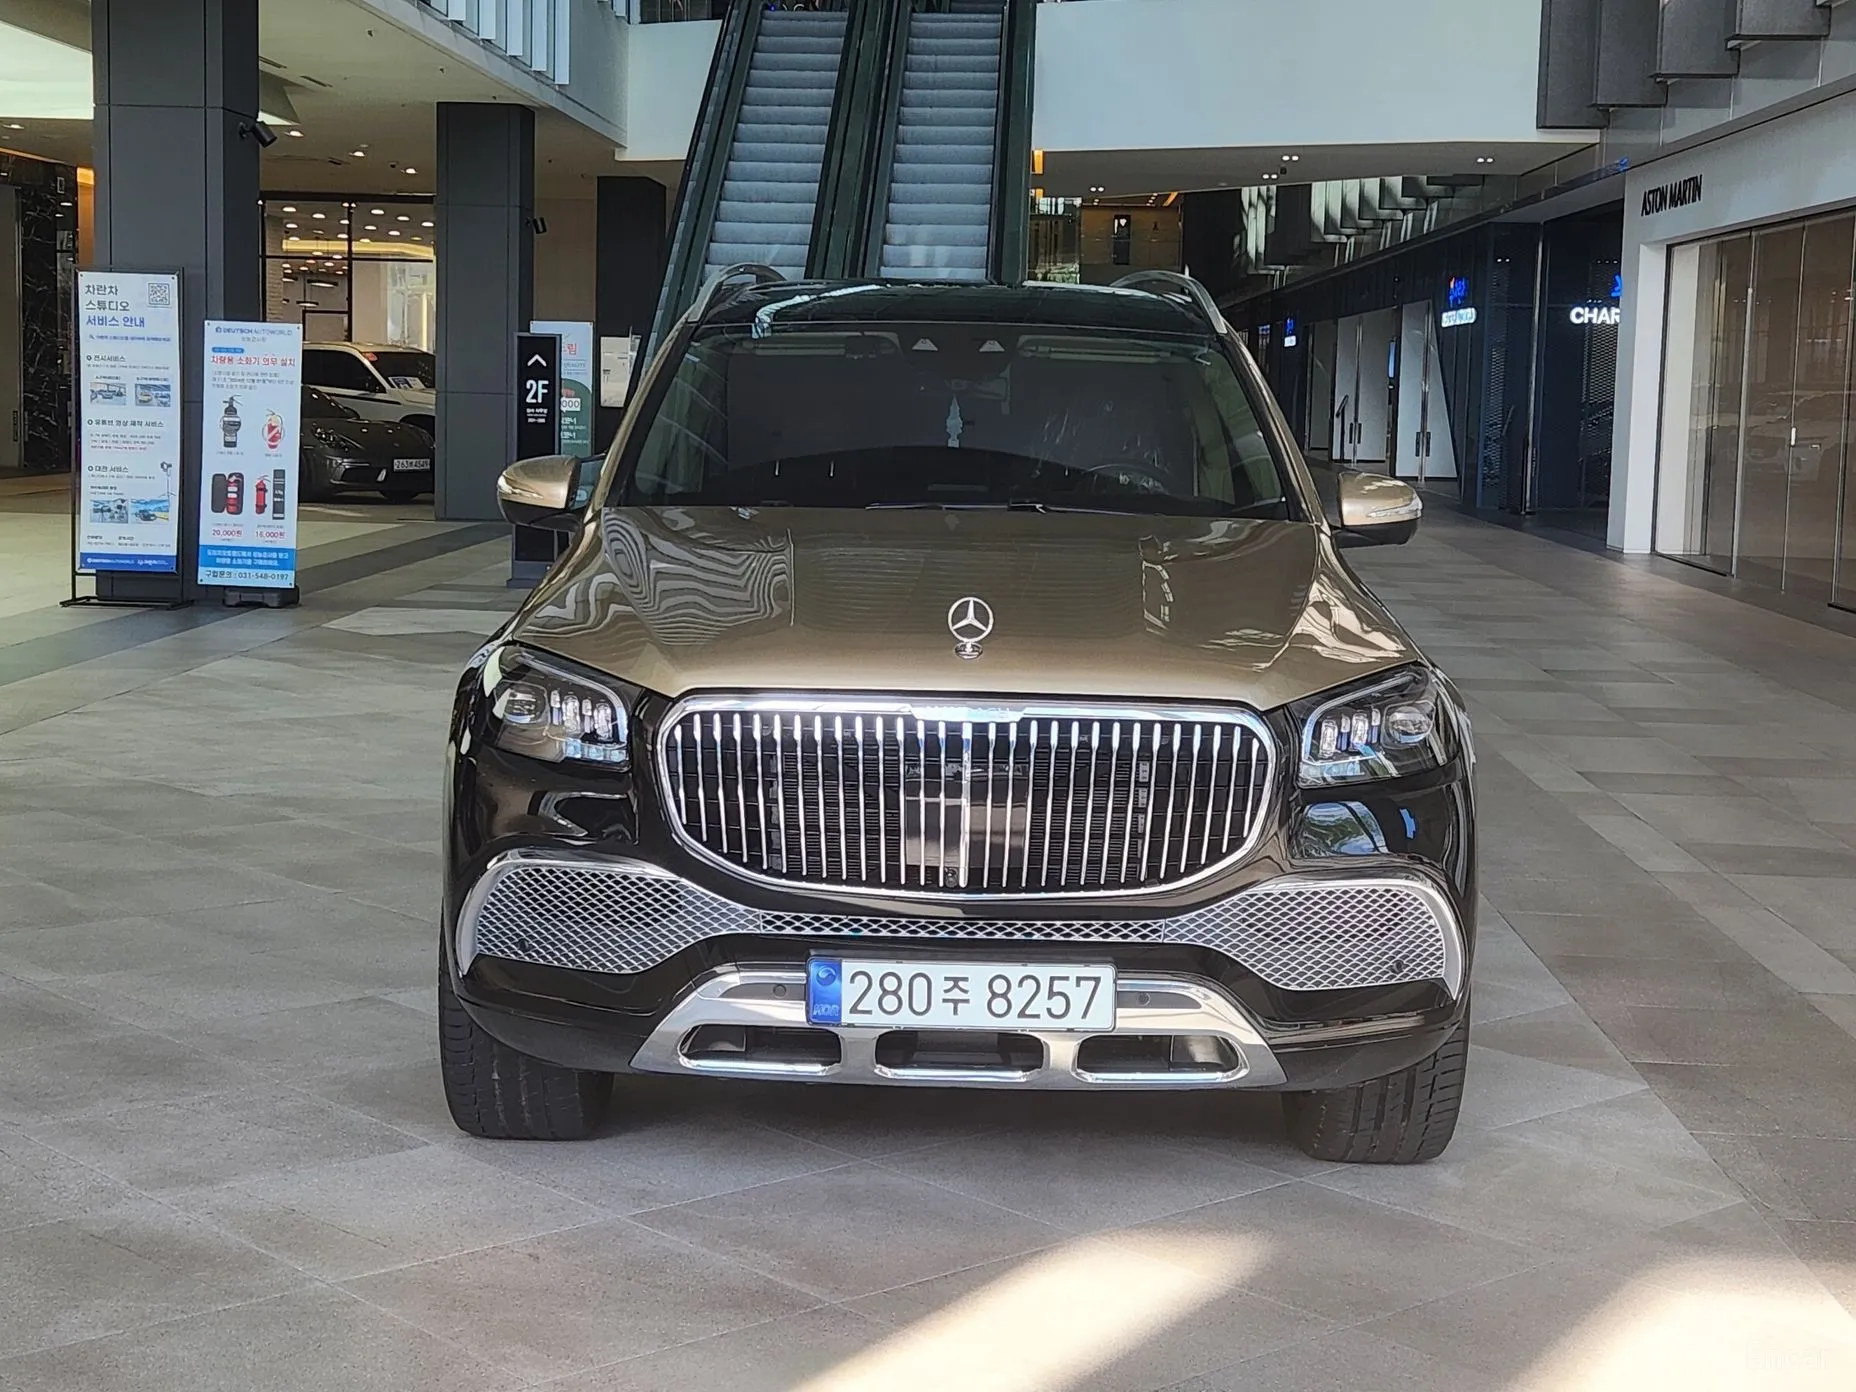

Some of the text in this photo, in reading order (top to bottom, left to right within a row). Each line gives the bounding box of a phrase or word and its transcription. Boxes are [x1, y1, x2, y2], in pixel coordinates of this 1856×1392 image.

[1641, 174, 1703, 217] ASTON MARTIN
[85, 284, 118, 296] 차란차
[85, 300, 130, 311] 스튜디오
[86, 315, 145, 328] 서비스 안내
[236, 356, 260, 366] 소화기
[526, 379, 549, 404] 2F
[212, 529, 242, 537] 20,000원
[849, 970, 1102, 1020] 280주 8257
